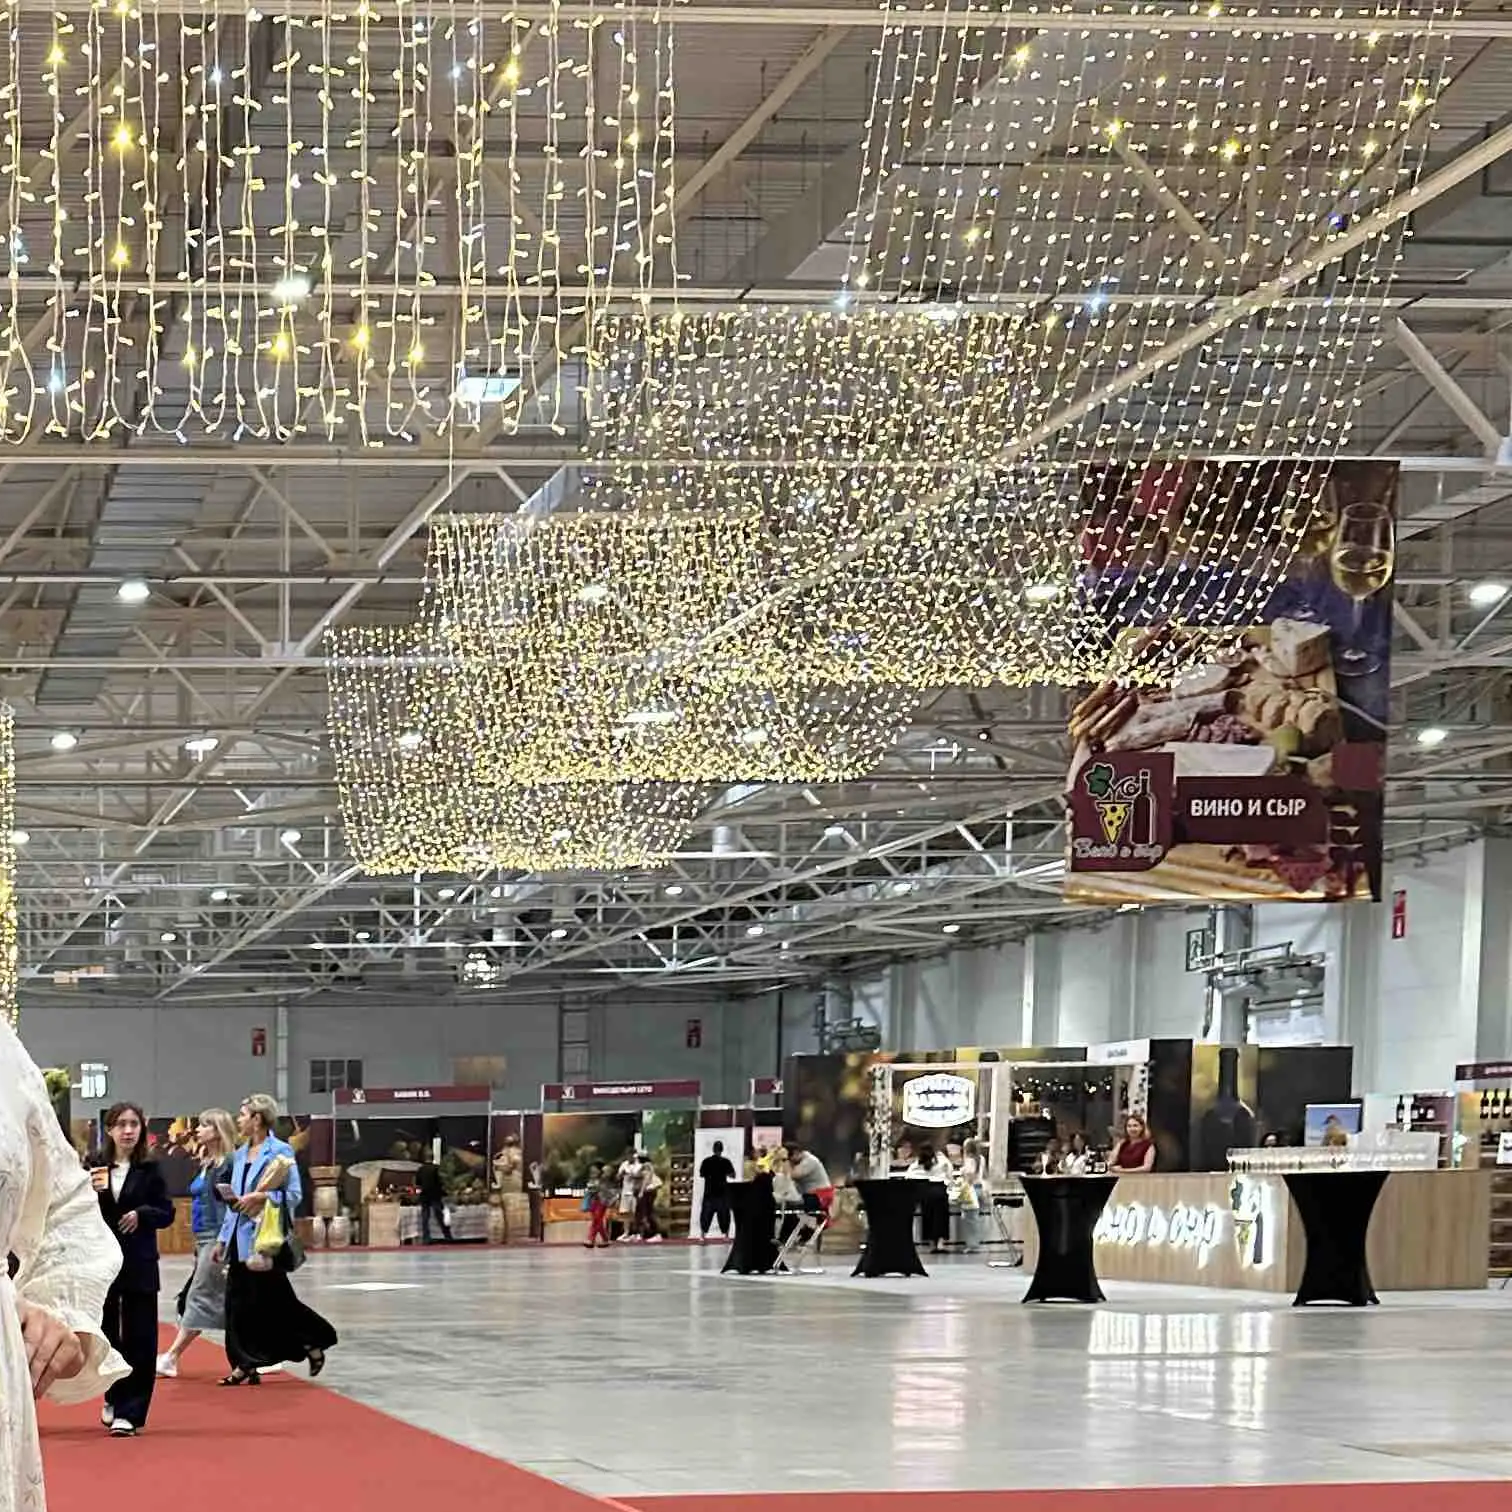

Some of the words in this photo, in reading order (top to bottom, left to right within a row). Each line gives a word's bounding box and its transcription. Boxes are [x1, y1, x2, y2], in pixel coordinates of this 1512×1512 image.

[1191, 799, 1243, 816] ВИНО
[1248, 799, 1261, 816] И
[1267, 799, 1307, 816] СЫР
